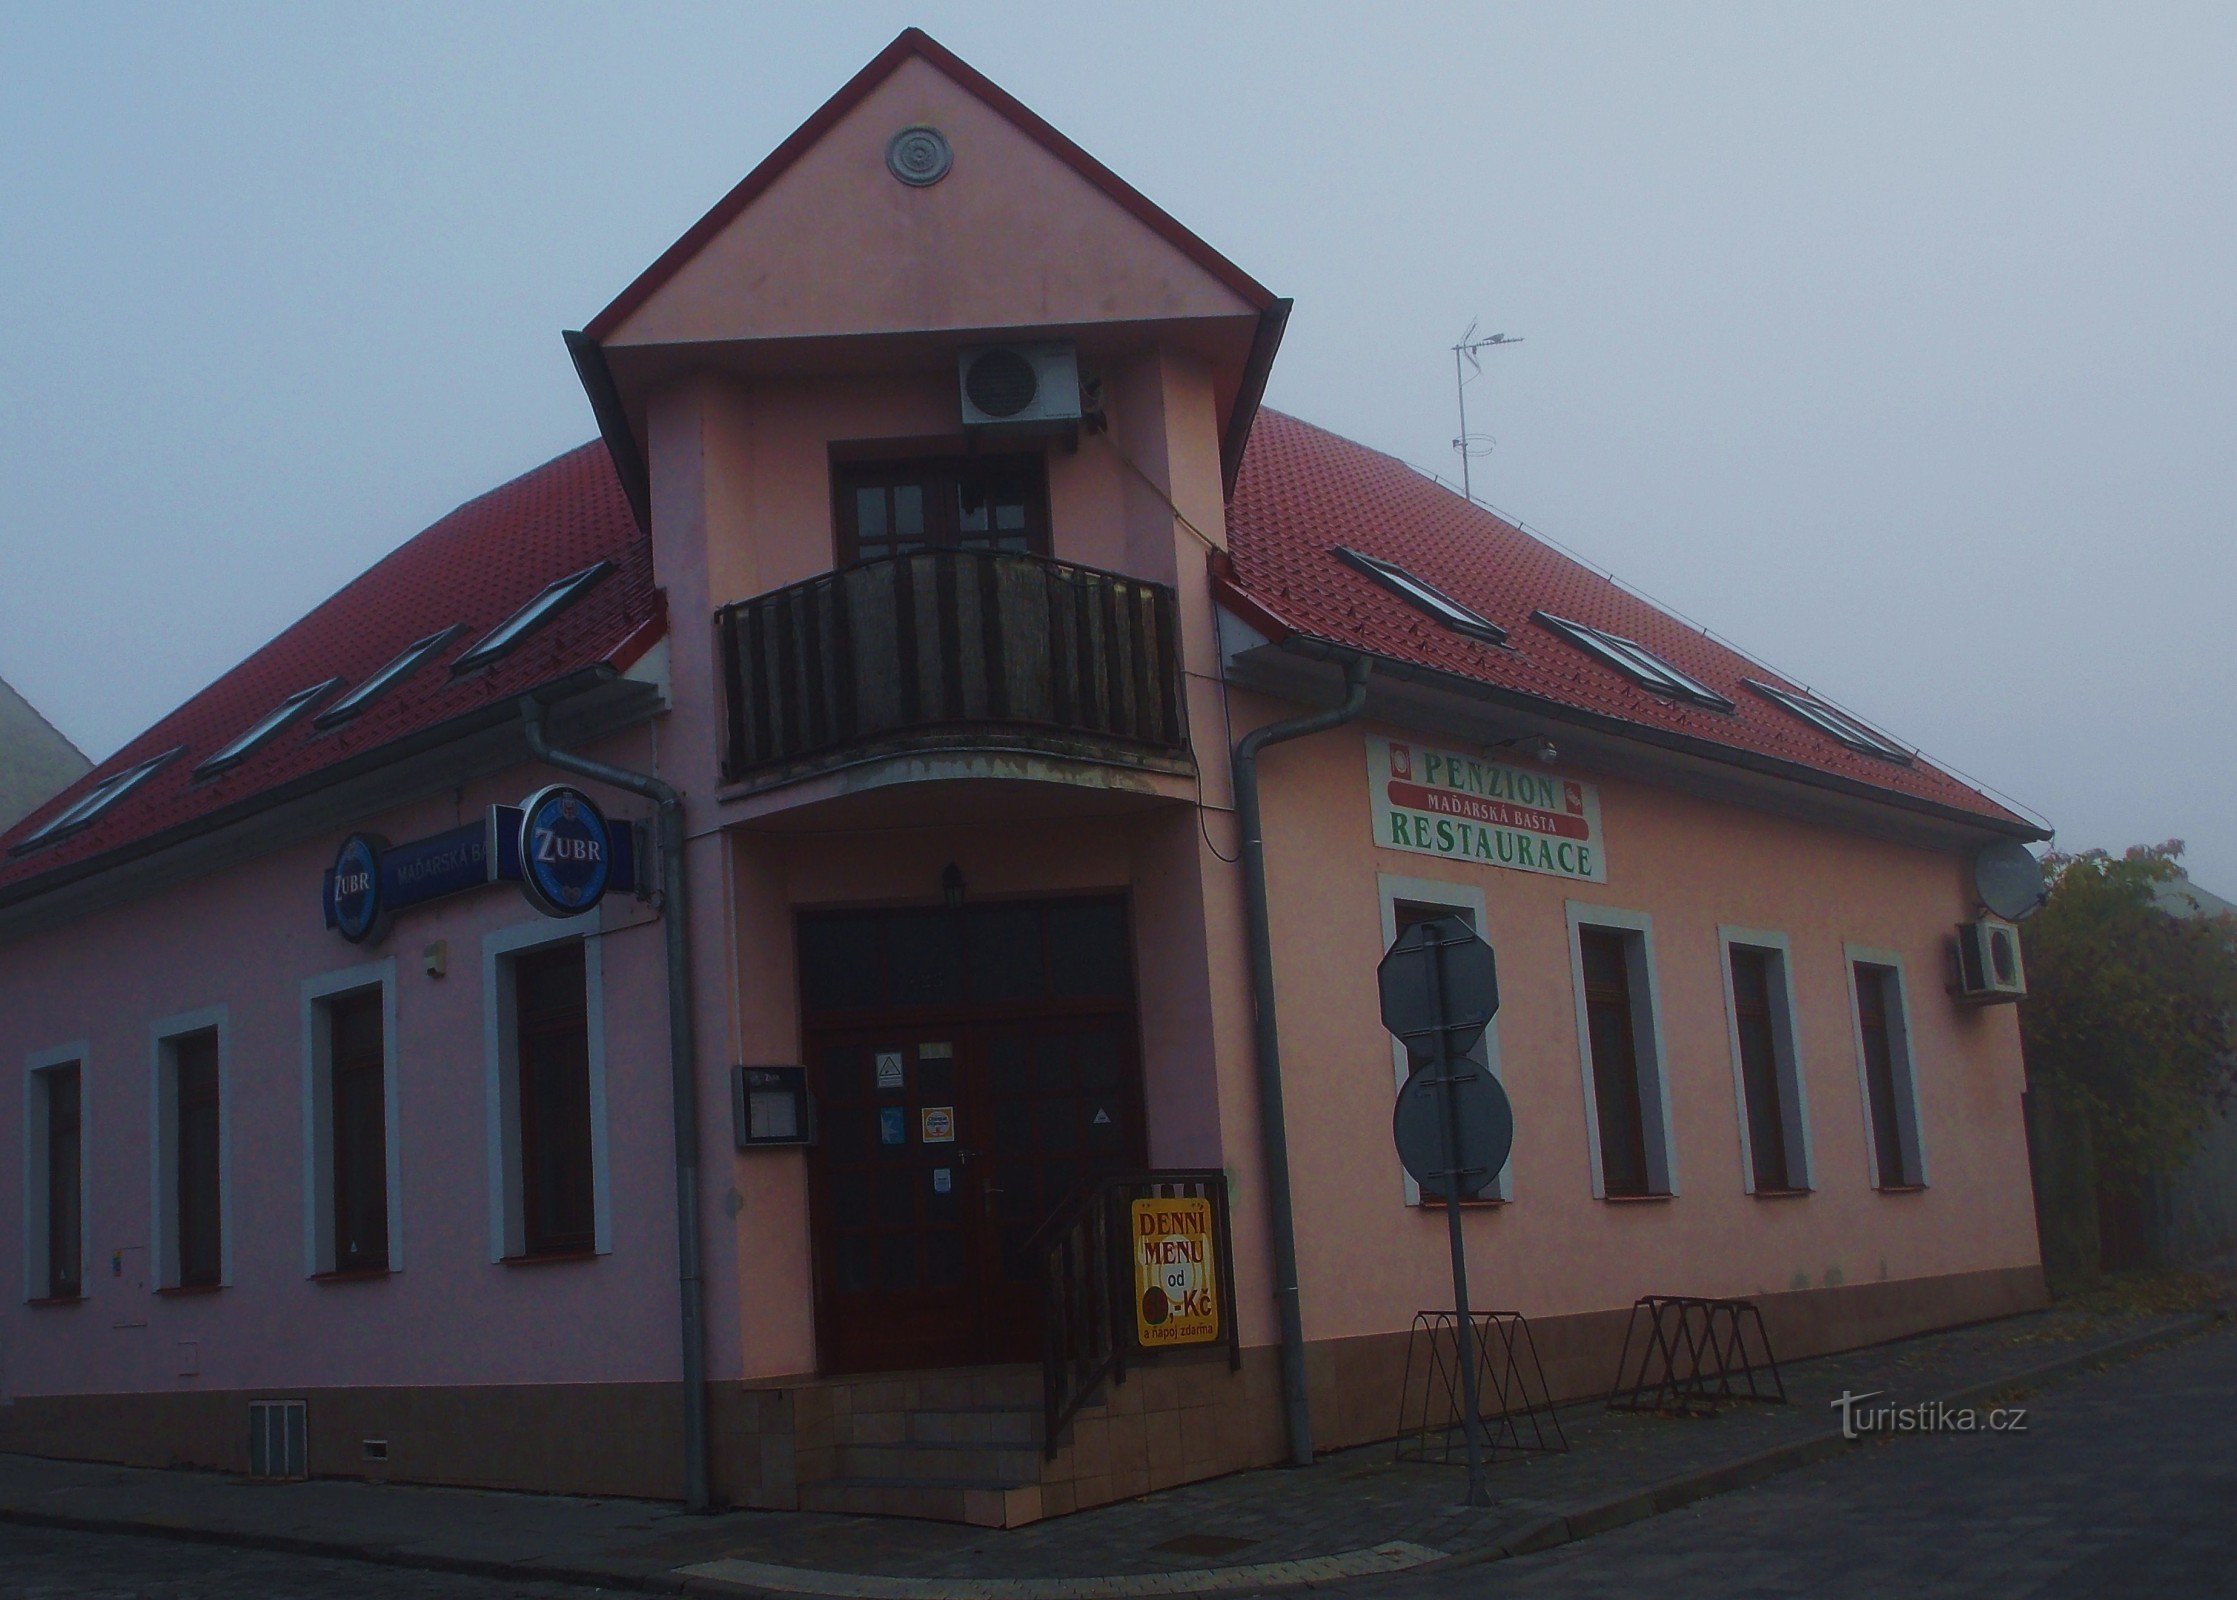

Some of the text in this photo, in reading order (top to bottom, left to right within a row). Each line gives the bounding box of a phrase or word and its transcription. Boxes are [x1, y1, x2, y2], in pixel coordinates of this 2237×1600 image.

[1424, 753, 1556, 809] PENZION
[1428, 793, 1557, 833] MAĎARSKÁ BAŠTA
[534, 826, 601, 863] ZUBR
[1389, 811, 1592, 876] RESTAURACE
[334, 872, 370, 902] ZUBR
[1139, 1206, 1206, 1236] DENNÍ
[1144, 1240, 1204, 1265] MENU
[1168, 1270, 1185, 1287] od
[1144, 1329, 1150, 1339] a
[1181, 1324, 1213, 1336] zdarma
